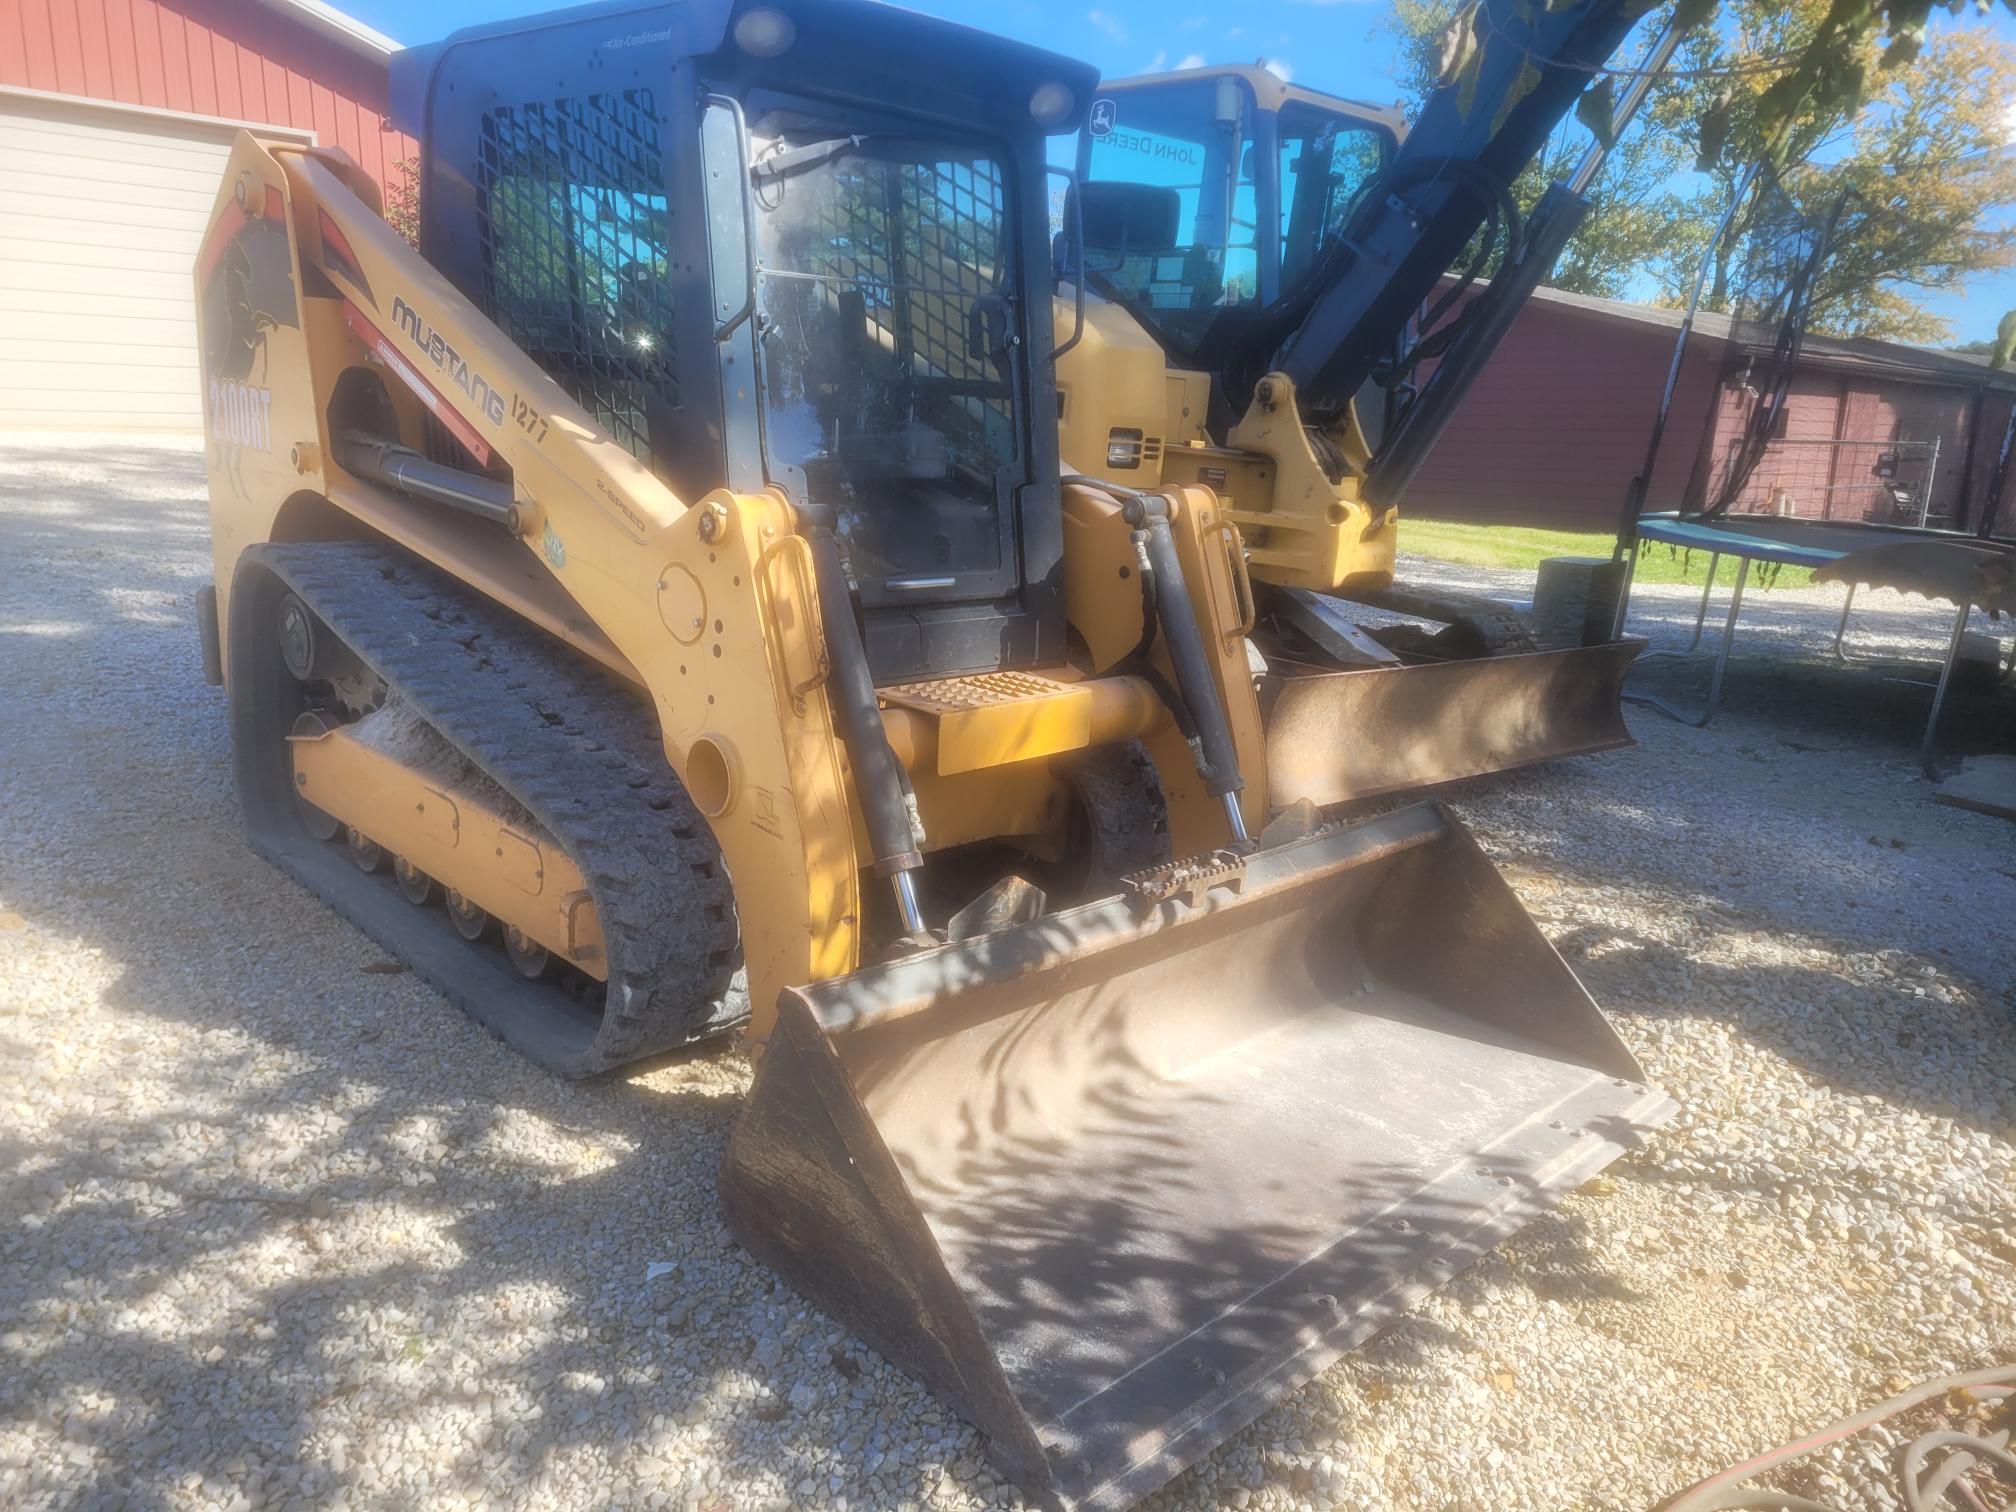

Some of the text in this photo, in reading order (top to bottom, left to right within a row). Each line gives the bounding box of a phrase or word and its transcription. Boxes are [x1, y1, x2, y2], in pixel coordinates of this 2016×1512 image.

[392, 295, 505, 427] MUSTANG
[512, 393, 549, 444] 1277
[209, 379, 271, 451] 2100RT
[596, 478, 646, 533] 2-SPEED
